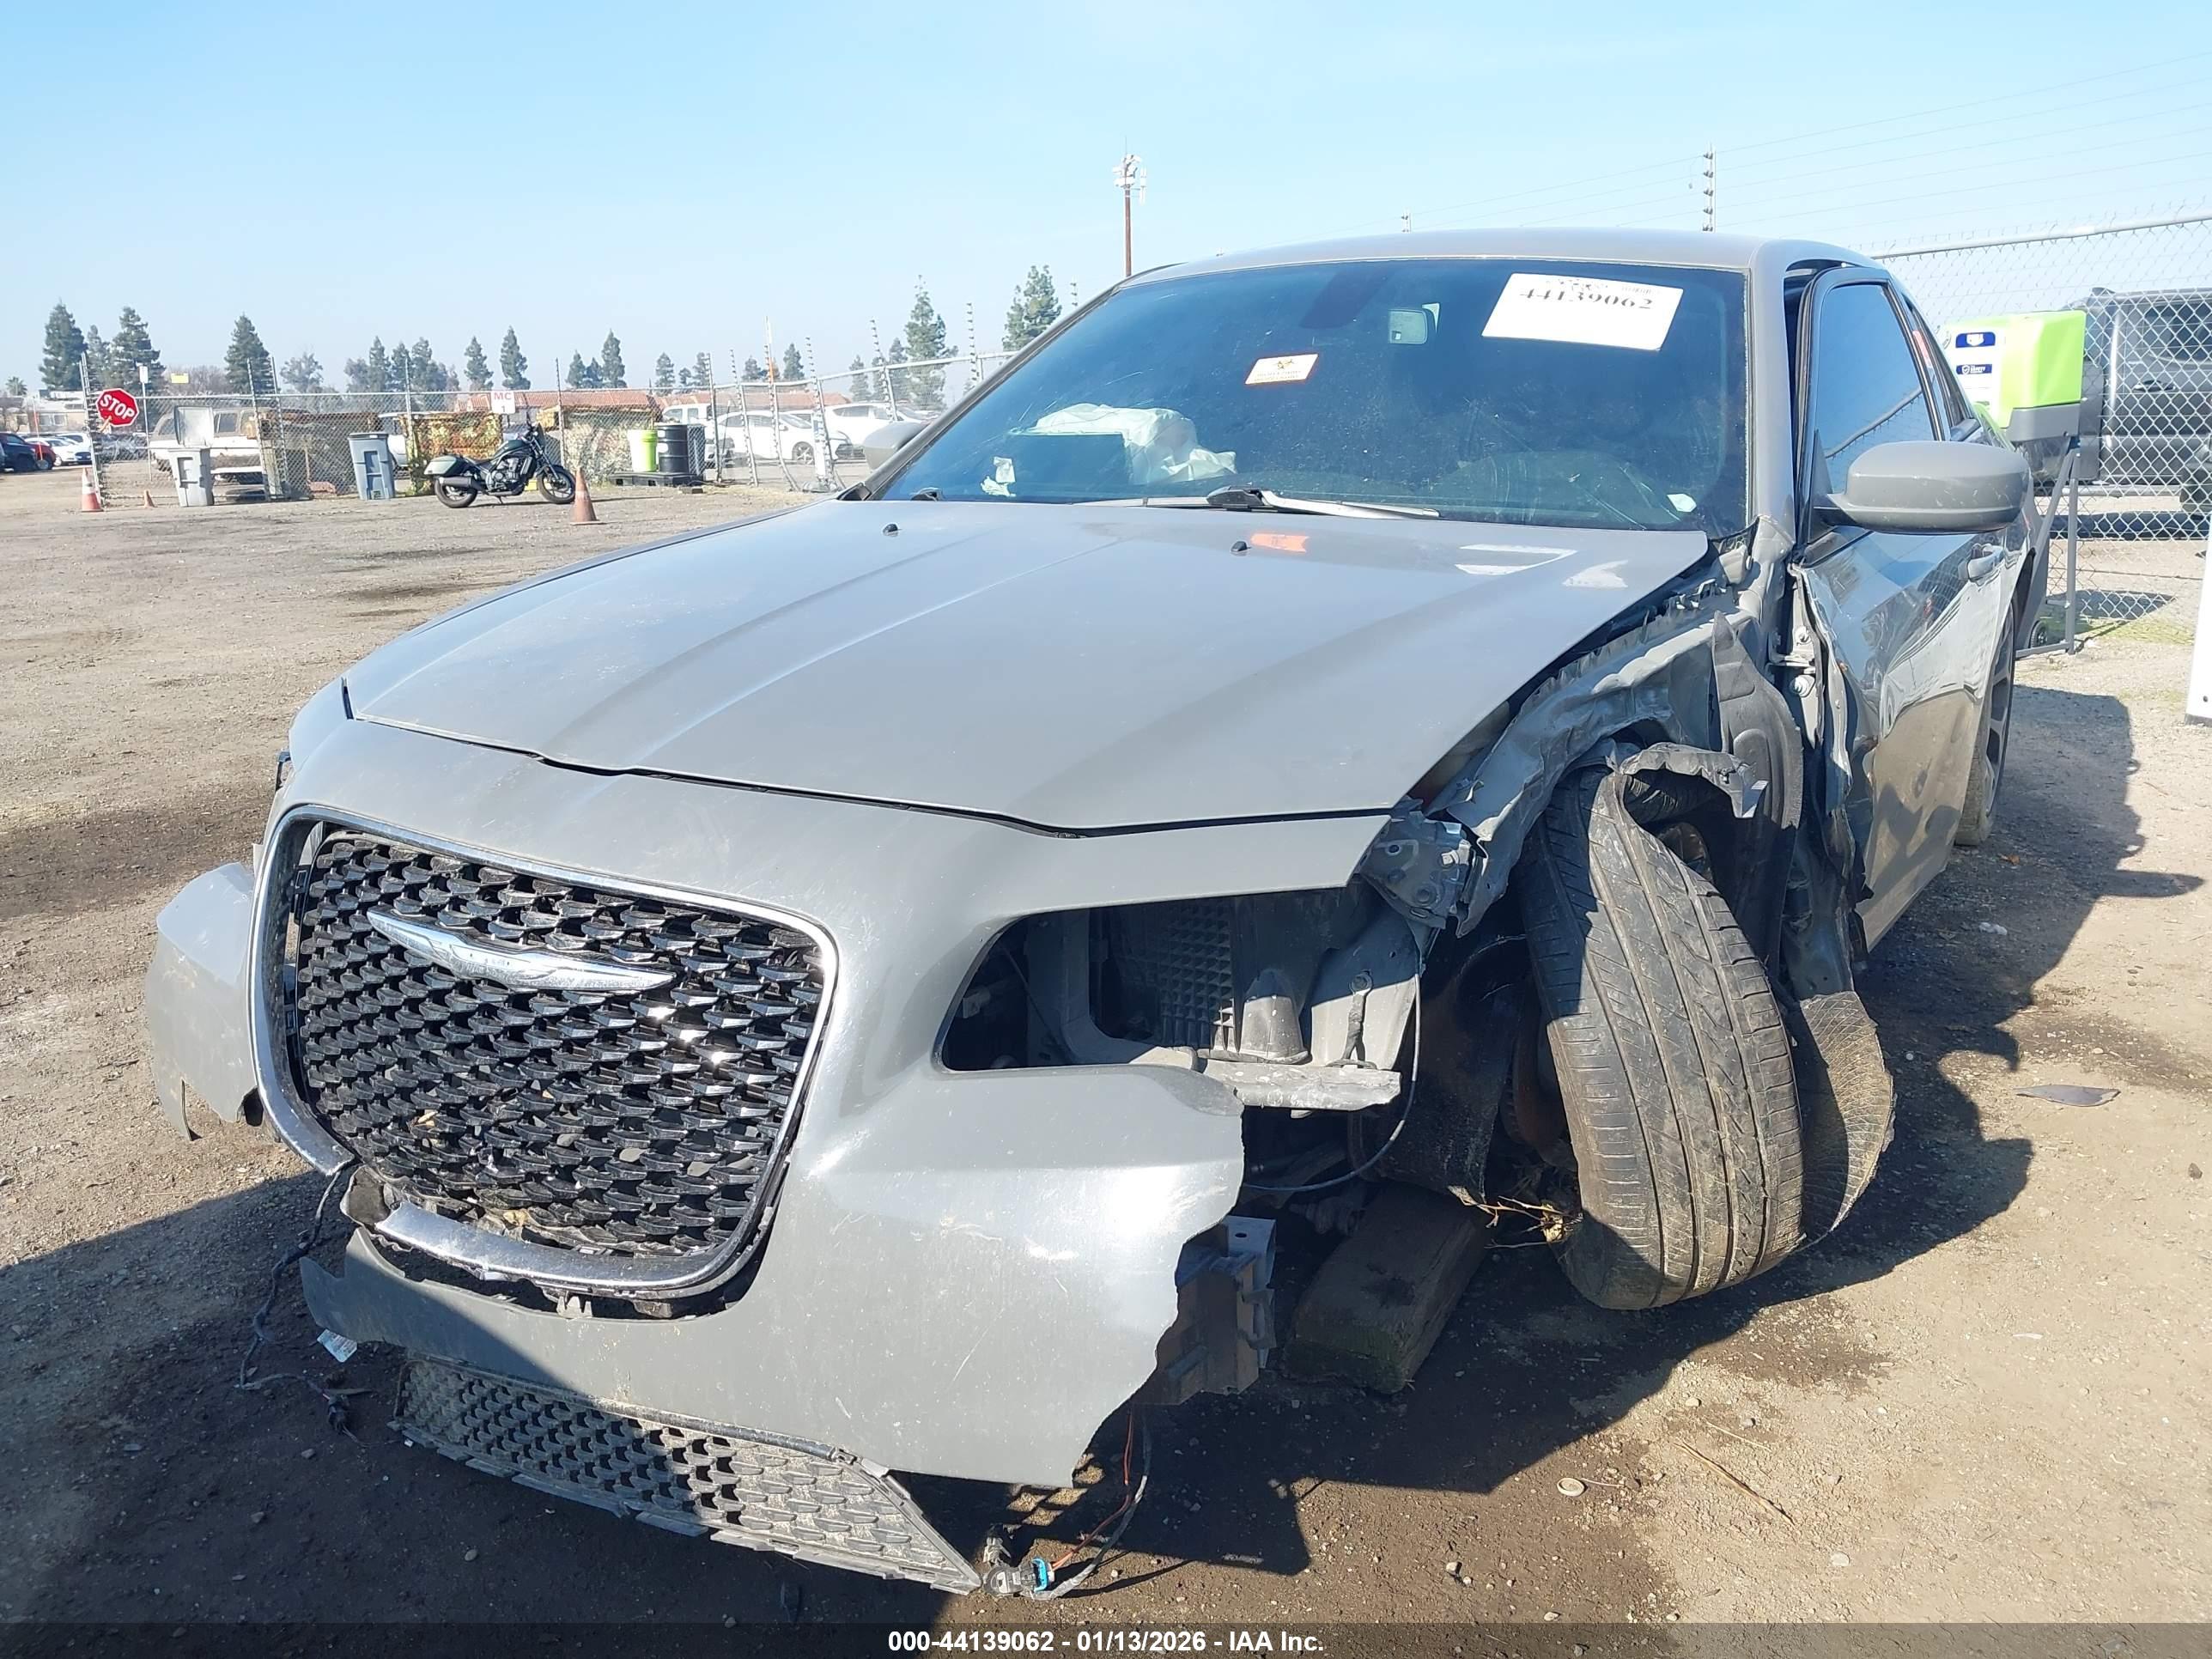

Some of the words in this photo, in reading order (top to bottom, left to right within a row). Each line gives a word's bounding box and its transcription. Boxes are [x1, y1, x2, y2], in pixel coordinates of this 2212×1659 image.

[1519, 289, 1653, 309] 44139062
[494, 392, 512, 400] MC
[100, 394, 136, 420] STOP
